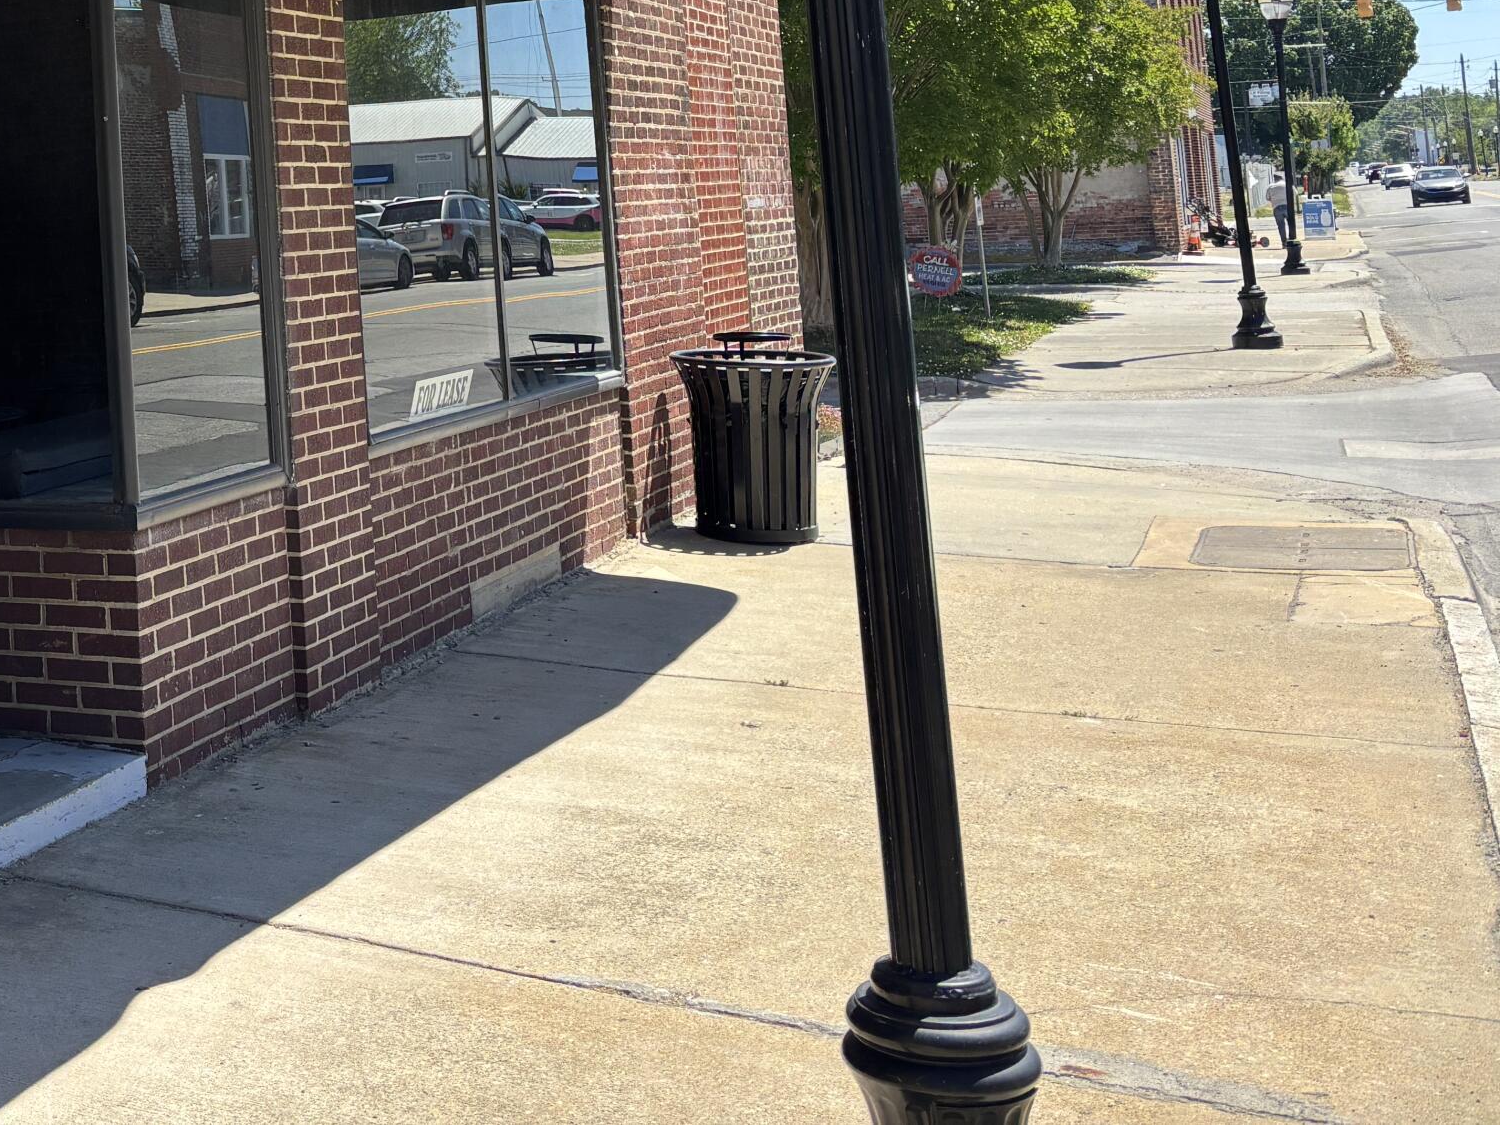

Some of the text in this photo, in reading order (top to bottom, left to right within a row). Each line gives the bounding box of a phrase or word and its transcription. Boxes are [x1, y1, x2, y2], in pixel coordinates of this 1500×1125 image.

[923, 255, 949, 266] CALL
[917, 264, 955, 276] PERNELL
[415, 375, 468, 414] FOR LEASE
